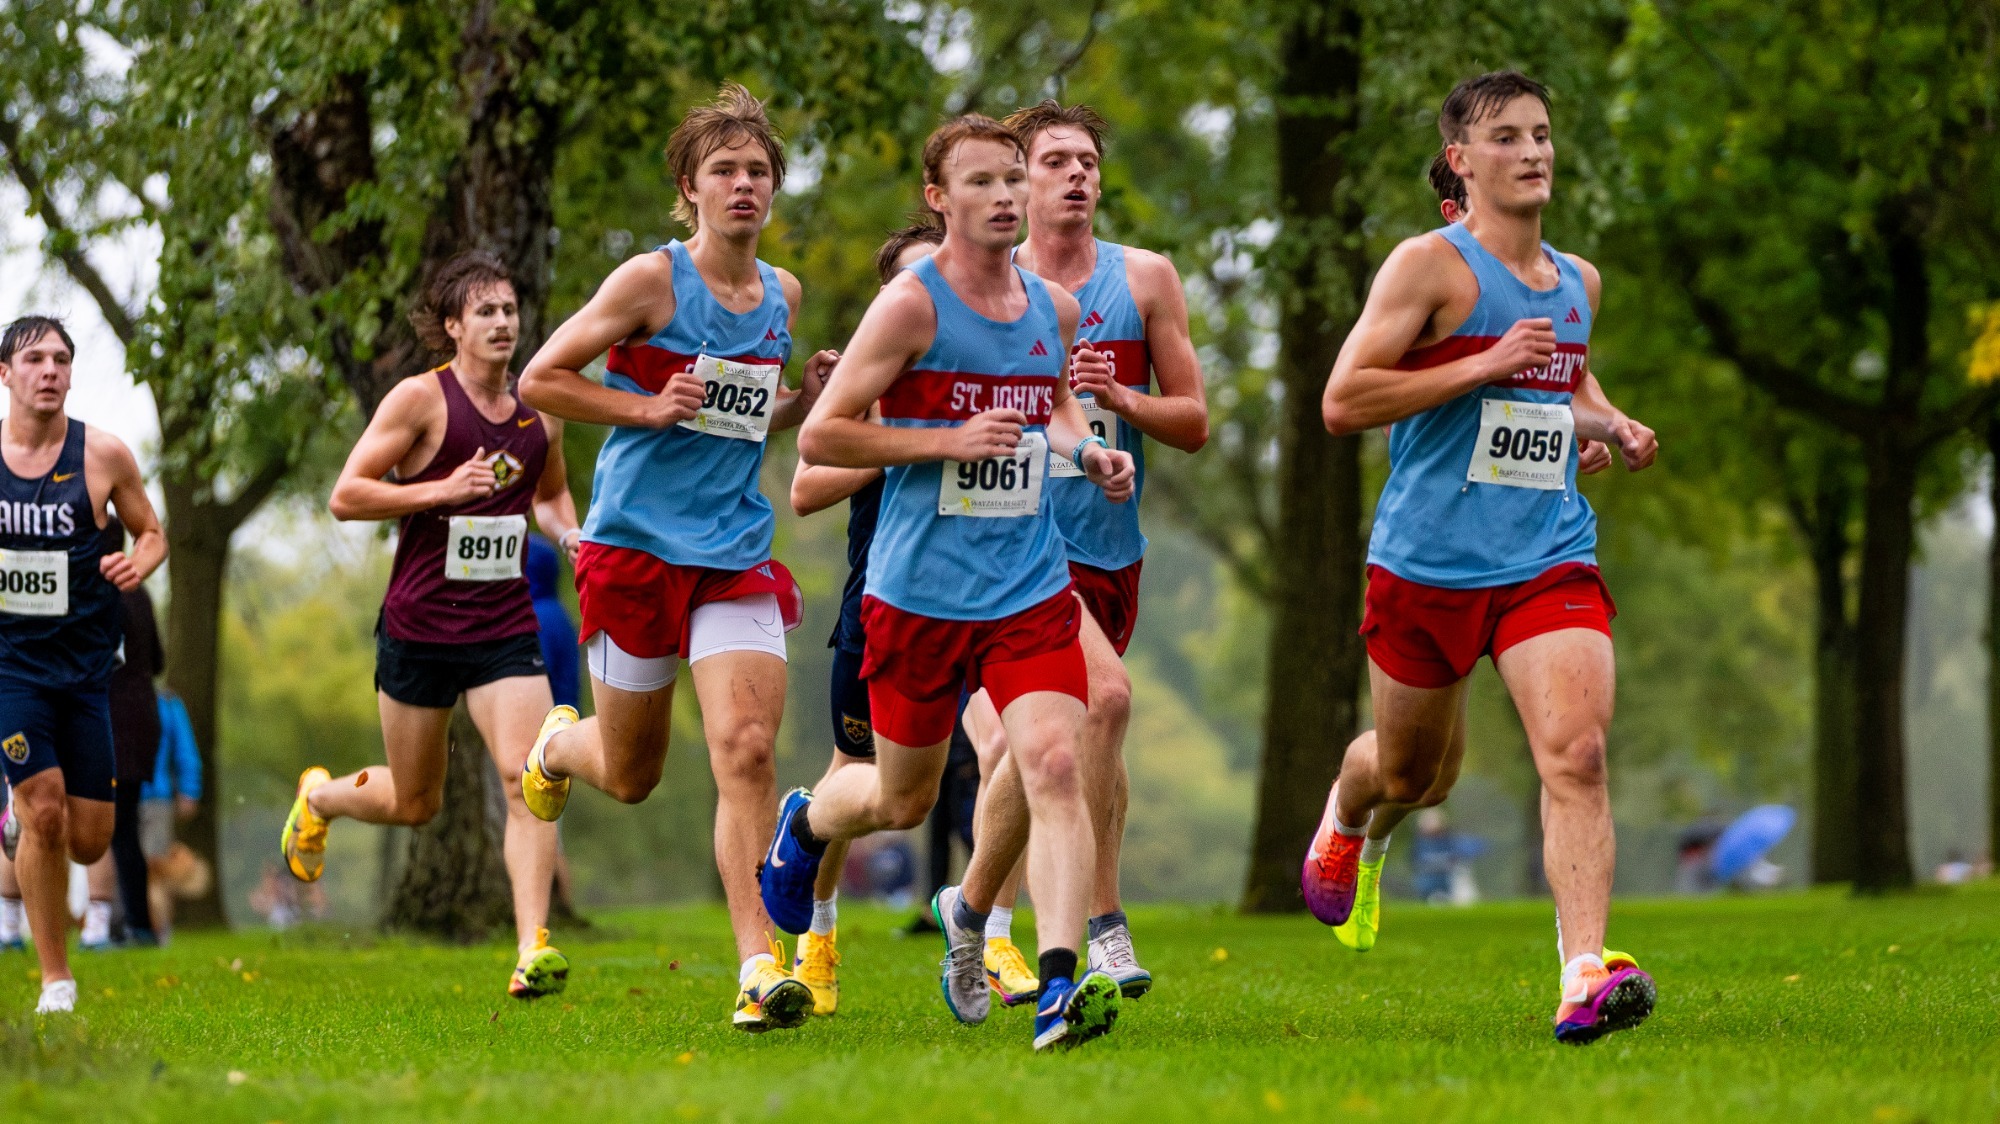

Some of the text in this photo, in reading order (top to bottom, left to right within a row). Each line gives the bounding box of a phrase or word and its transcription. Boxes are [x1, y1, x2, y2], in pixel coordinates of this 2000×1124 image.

[702, 380, 768, 418] 9052
[985, 385, 1053, 415] JOHN'S
[1489, 426, 1563, 463] 9059
[957, 457, 1032, 491] 9061
[0, 500, 75, 536] AINTS
[458, 535, 517, 560] 8910
